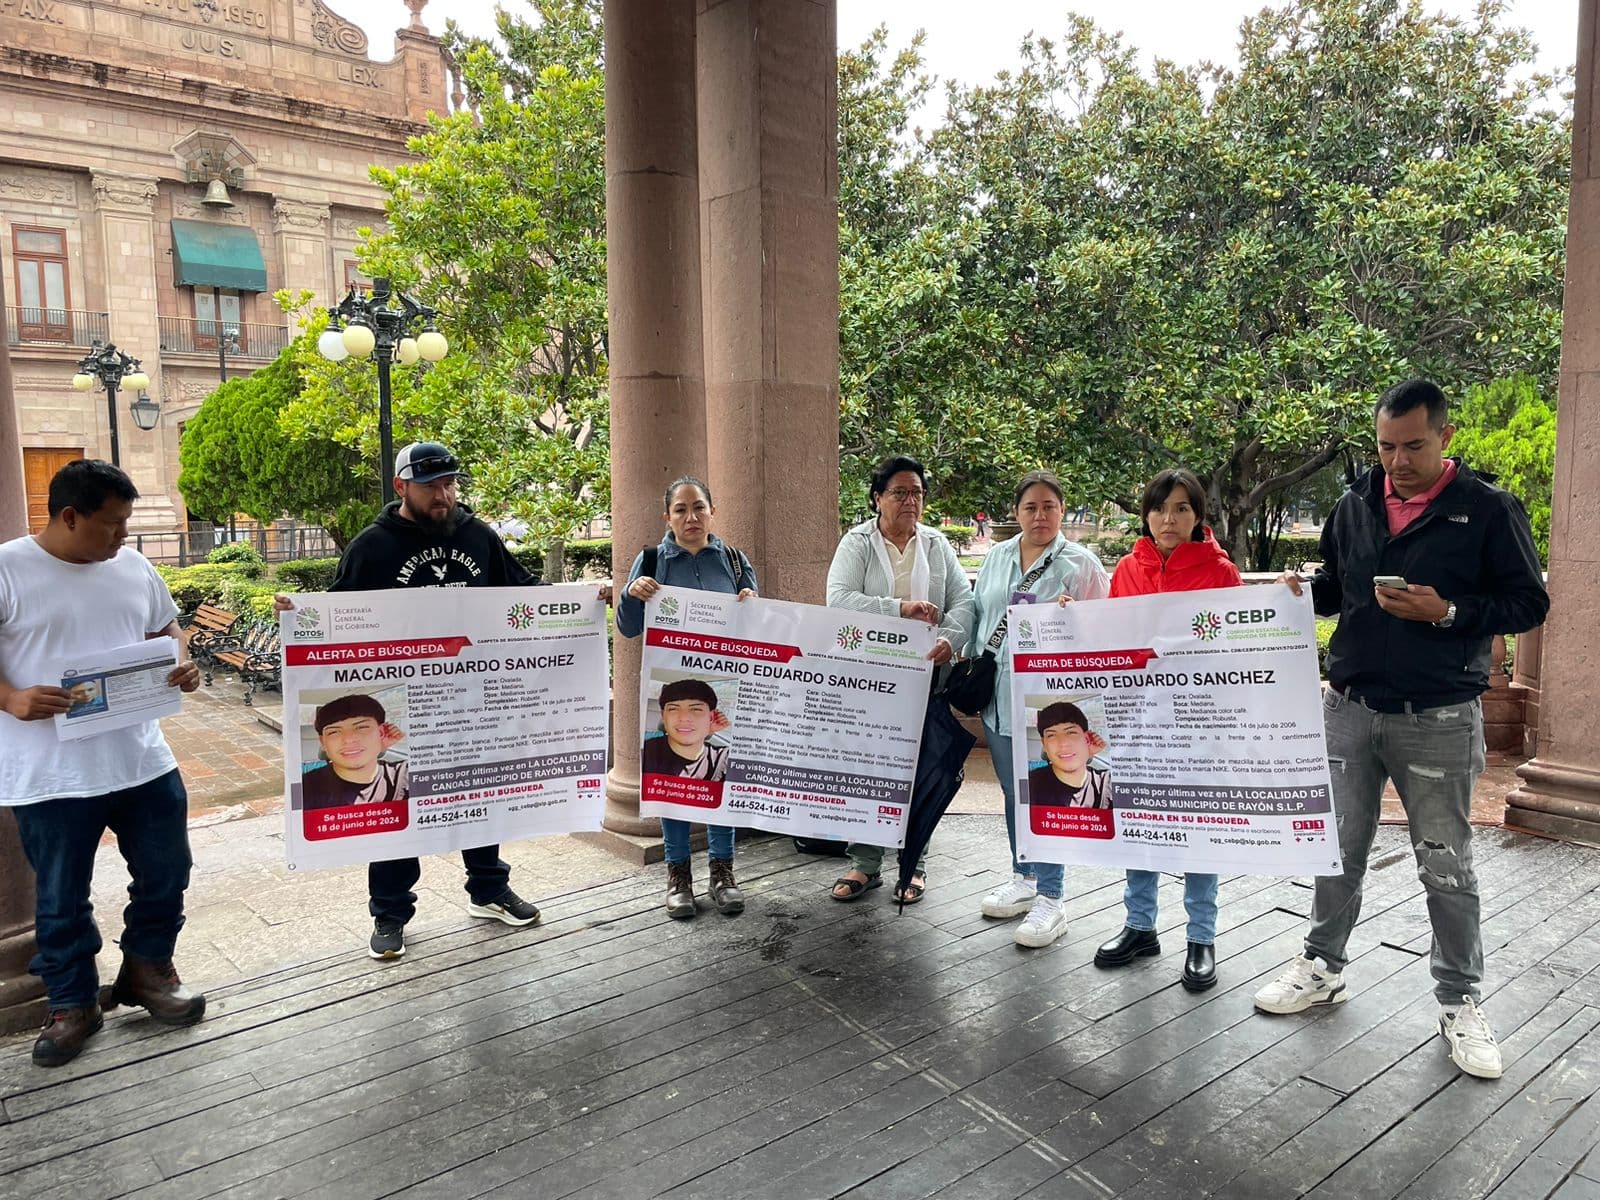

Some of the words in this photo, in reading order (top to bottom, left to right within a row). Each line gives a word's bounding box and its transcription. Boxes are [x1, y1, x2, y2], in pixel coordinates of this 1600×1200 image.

[223, 6, 267, 29] 1950
[181, 31, 241, 59] JUS.
[337, 62, 384, 88] LEX.
[451, 549, 481, 577] EAGLE
[334, 606, 372, 615] SECRETARÍA
[538, 603, 581, 616] CEBP
[690, 610, 715, 618] GENERAL
[1225, 609, 1276, 625] CEBP
[697, 617, 727, 626] GOBIERNO
[866, 631, 909, 645] CEBP
[307, 649, 356, 661] ALERTA
[358, 648, 376, 657] DE
[378, 644, 445, 657] BÚSQUEDA
[662, 635, 701, 648] ALERTA
[704, 641, 719, 650] DE
[721, 643, 778, 658] BÚSQUEDA
[335, 665, 415, 683] MACARIO
[421, 659, 500, 677] EDUARDO
[505, 654, 575, 671] SANCHEZ
[1028, 659, 1058, 668] ALERTA
[1060, 659, 1073, 667] DE
[1076, 655, 1133, 667] BÚSQUEDA
[681, 656, 749, 674] MACARIO
[753, 665, 824, 684] EDUARDO
[828, 675, 897, 695] SANCHEZ
[1046, 677, 1108, 690] MACARIO
[1113, 673, 1188, 688] EDUARDO
[1193, 670, 1275, 686] SANCHEZ
[413, 774, 429, 783] Fue
[432, 772, 454, 781] visto
[456, 770, 469, 780] por
[472, 766, 498, 777] última
[528, 758, 539, 768] LA
[541, 753, 591, 767] LOCALIDAD
[592, 753, 604, 761] DE
[432, 779, 471, 792] CANOAS
[472, 773, 517, 786] MUNICIPIO
[520, 771, 532, 780] DE
[534, 766, 563, 778] RAYÓN
[566, 764, 588, 774] S.L.P.
[730, 762, 746, 770] Fue
[748, 764, 766, 773] visto
[768, 767, 781, 776] por
[782, 768, 807, 779] última
[835, 775, 846, 783] LA
[848, 777, 896, 790] LOCALIDAD
[898, 783, 909, 791] DE
[664, 780, 685, 790] busca
[687, 783, 709, 793] desde
[745, 774, 780, 785] CANOAS
[781, 778, 824, 791] MUNICIPIO
[827, 784, 838, 792] DE
[840, 784, 869, 796] RAYÓN
[870, 790, 891, 799] S.L.P.
[1115, 786, 1130, 794] Fue
[1152, 789, 1166, 797] por
[1168, 787, 1196, 798] última
[1230, 790, 1243, 798] LA
[1246, 789, 1308, 800] LOCALIDAD
[1311, 789, 1325, 798] DE
[417, 794, 466, 806] COLABORA
[483, 790, 495, 798] SU
[498, 784, 544, 796] BÚSQUEDA
[666, 789, 685, 798] junio
[696, 794, 714, 802] 2024
[731, 785, 773, 796] COLABORA
[790, 792, 800, 800] SU
[803, 793, 846, 806] BÚSQUEDA
[728, 799, 791, 815] 444-524-1481
[880, 806, 902, 815] 911
[1170, 800, 1219, 810] MUNICIPIO
[1222, 801, 1235, 810] DE
[1238, 800, 1273, 811] RAYÓN
[1277, 802, 1306, 811] S.L.P.
[324, 814, 335, 822] Se
[337, 811, 364, 820] busca
[366, 808, 393, 817] desde
[417, 807, 488, 825] 444-524-1481
[1058, 812, 1078, 820] busca
[1080, 813, 1100, 821] desde
[1182, 815, 1194, 823] SU
[1197, 815, 1250, 825] BÚSQUEDA
[342, 821, 364, 831] junio
[367, 819, 377, 827] de
[380, 817, 400, 825] 2024
[1062, 822, 1079, 831] junio
[1091, 824, 1107, 832] 2024
[1294, 820, 1324, 830] 911
